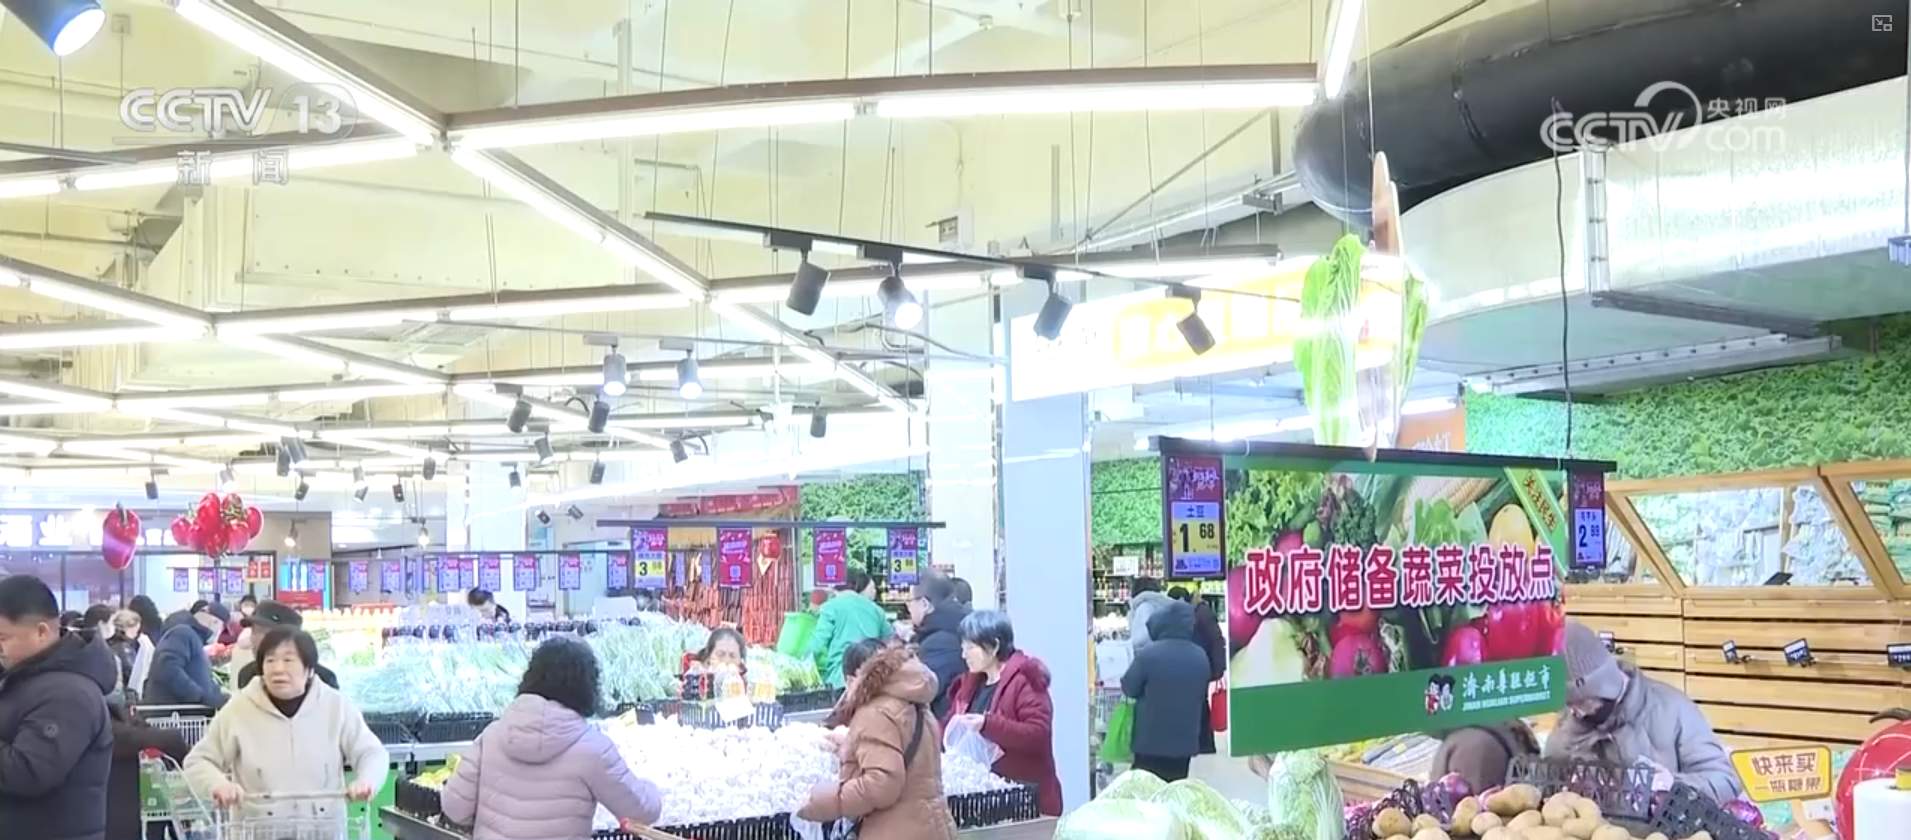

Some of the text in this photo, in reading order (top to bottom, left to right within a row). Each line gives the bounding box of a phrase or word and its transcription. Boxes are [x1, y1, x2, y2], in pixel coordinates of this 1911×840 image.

[1186, 505, 1206, 518] 土豆
[1245, 544, 1555, 616] 政府储备蔬菜投放点
[1751, 751, 1817, 776] 快来买
